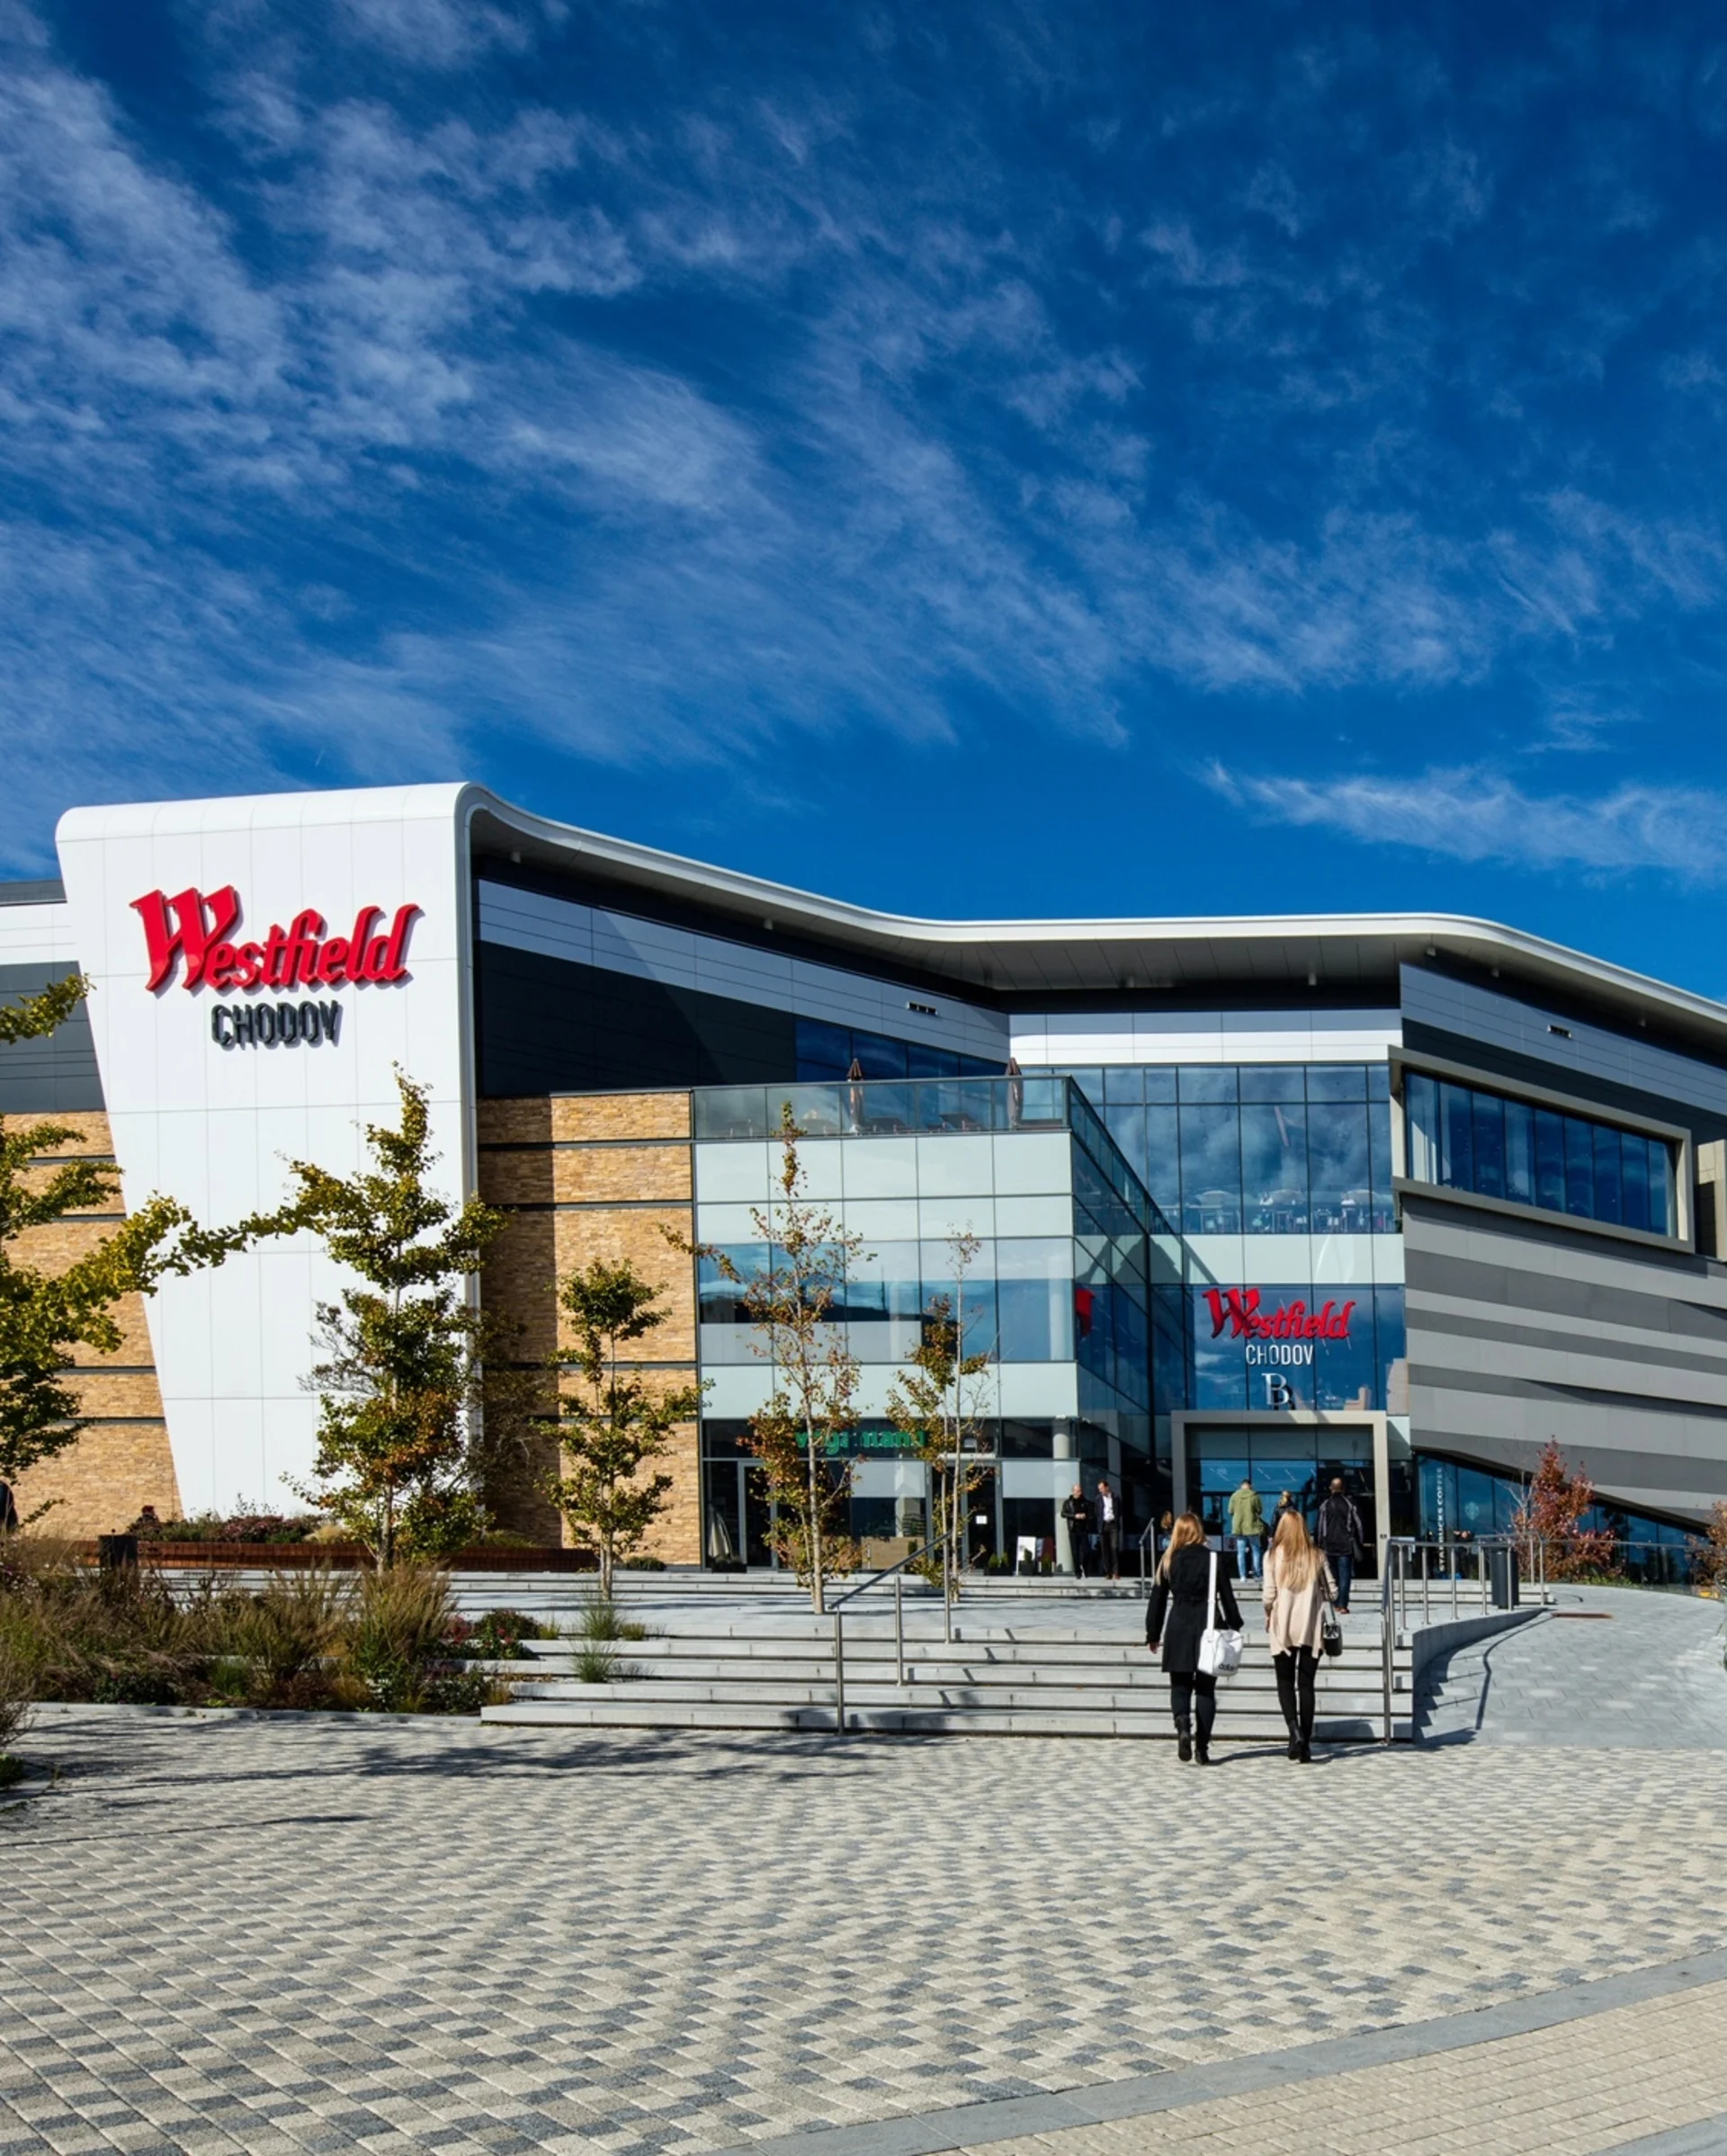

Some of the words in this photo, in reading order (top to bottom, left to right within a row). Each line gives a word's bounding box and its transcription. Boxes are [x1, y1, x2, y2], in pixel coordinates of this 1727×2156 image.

[130, 884, 419, 994] Westfield
[211, 999, 343, 1049] CHODOV
[1202, 1287, 1356, 1339] Westfield
[1246, 1344, 1314, 1365] CHODOV
[1261, 1373, 1290, 1405] B
